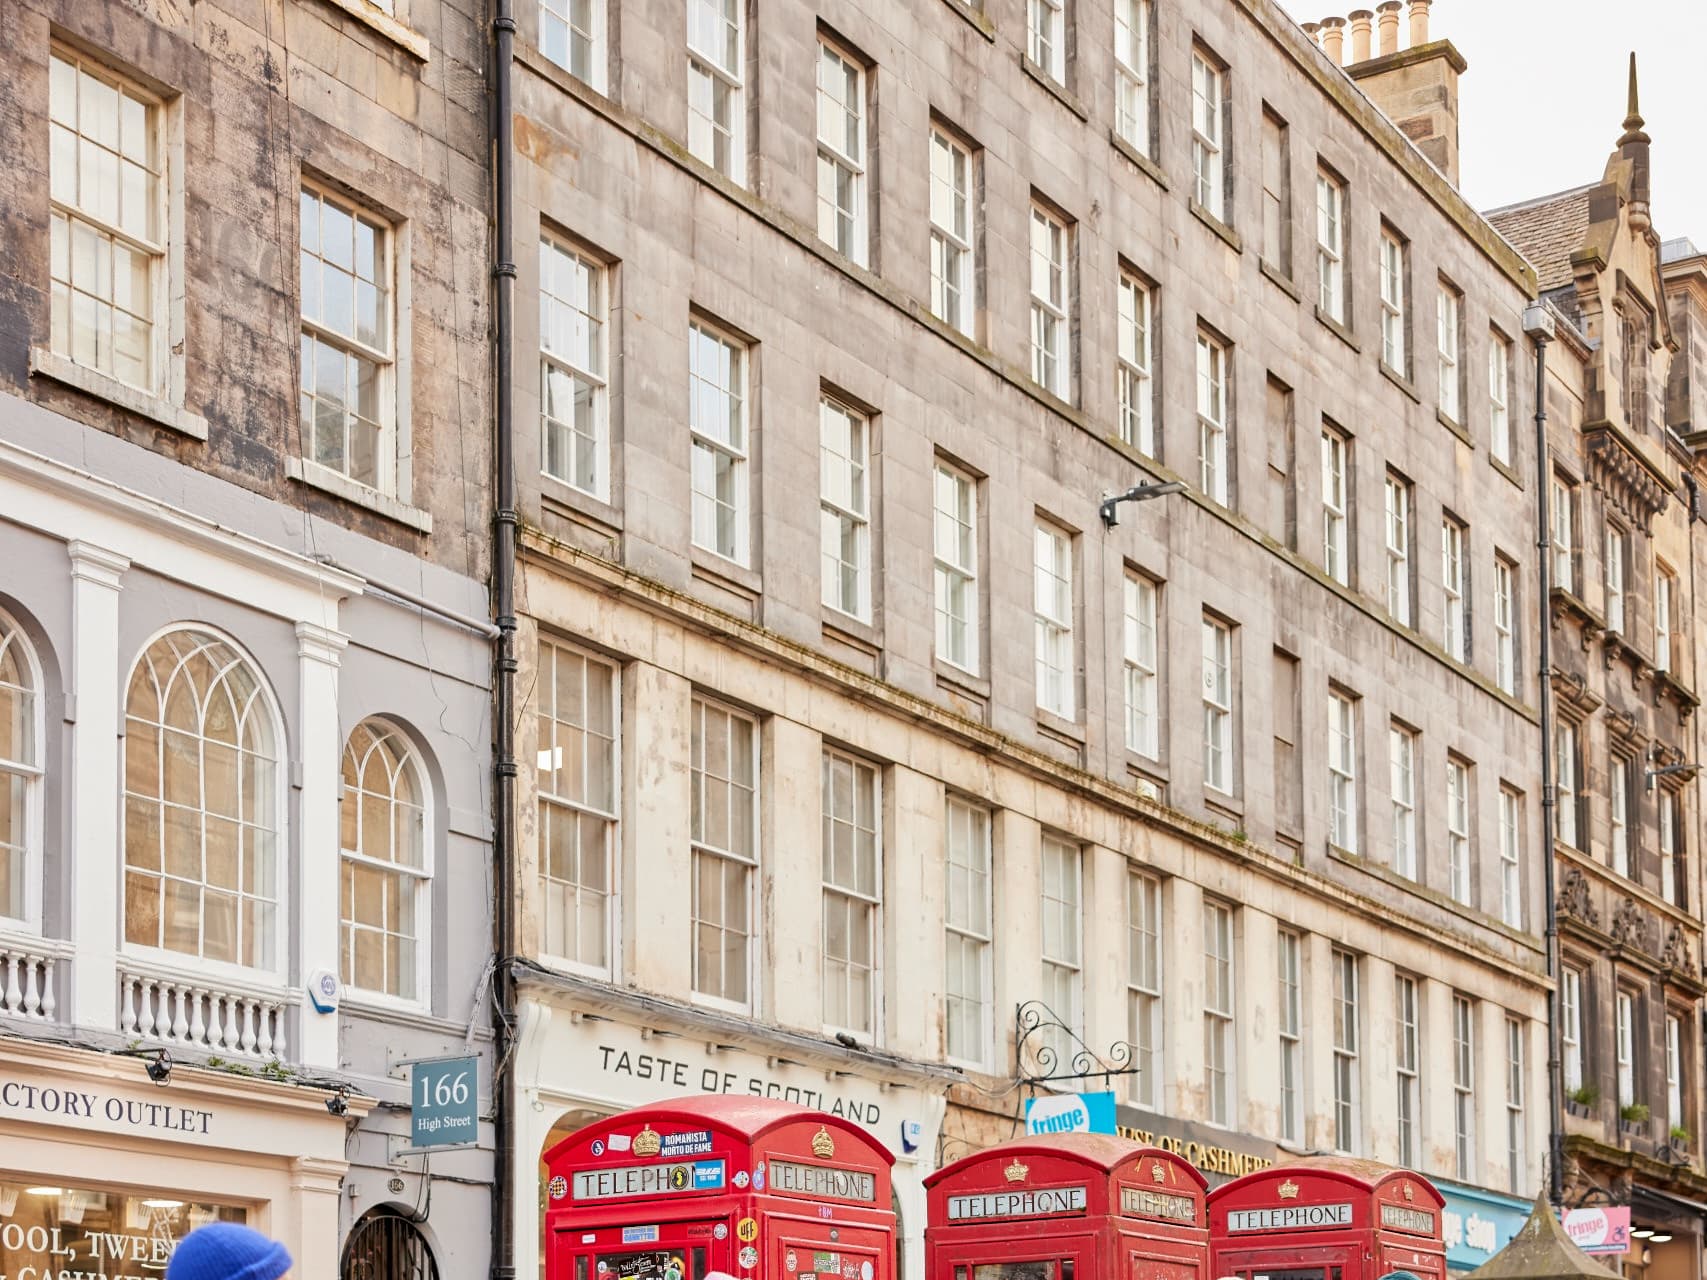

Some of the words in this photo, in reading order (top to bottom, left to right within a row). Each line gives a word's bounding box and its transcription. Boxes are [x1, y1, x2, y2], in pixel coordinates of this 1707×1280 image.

[420, 1072, 469, 1107] 166
[599, 1046, 689, 1086] TASTE
[701, 1069, 737, 1095] OF
[748, 1079, 881, 1125] SCOTLAND
[0, 1082, 98, 1117] CTORY
[105, 1098, 213, 1134] OUTLET
[1032, 1109, 1084, 1134] fringe
[418, 1118, 441, 1132] High
[443, 1116, 471, 1128] Street
[665, 1131, 708, 1145] ROMANISTA
[685, 1144, 693, 1154] DE
[694, 1142, 712, 1152] FAME
[582, 1165, 697, 1197] TELEPH
[772, 1164, 869, 1199] TELEPHONE
[954, 1190, 1081, 1217] TELEPHONE
[1234, 1205, 1349, 1229] TELEPHONE
[0, 1223, 76, 1262] OOL,
